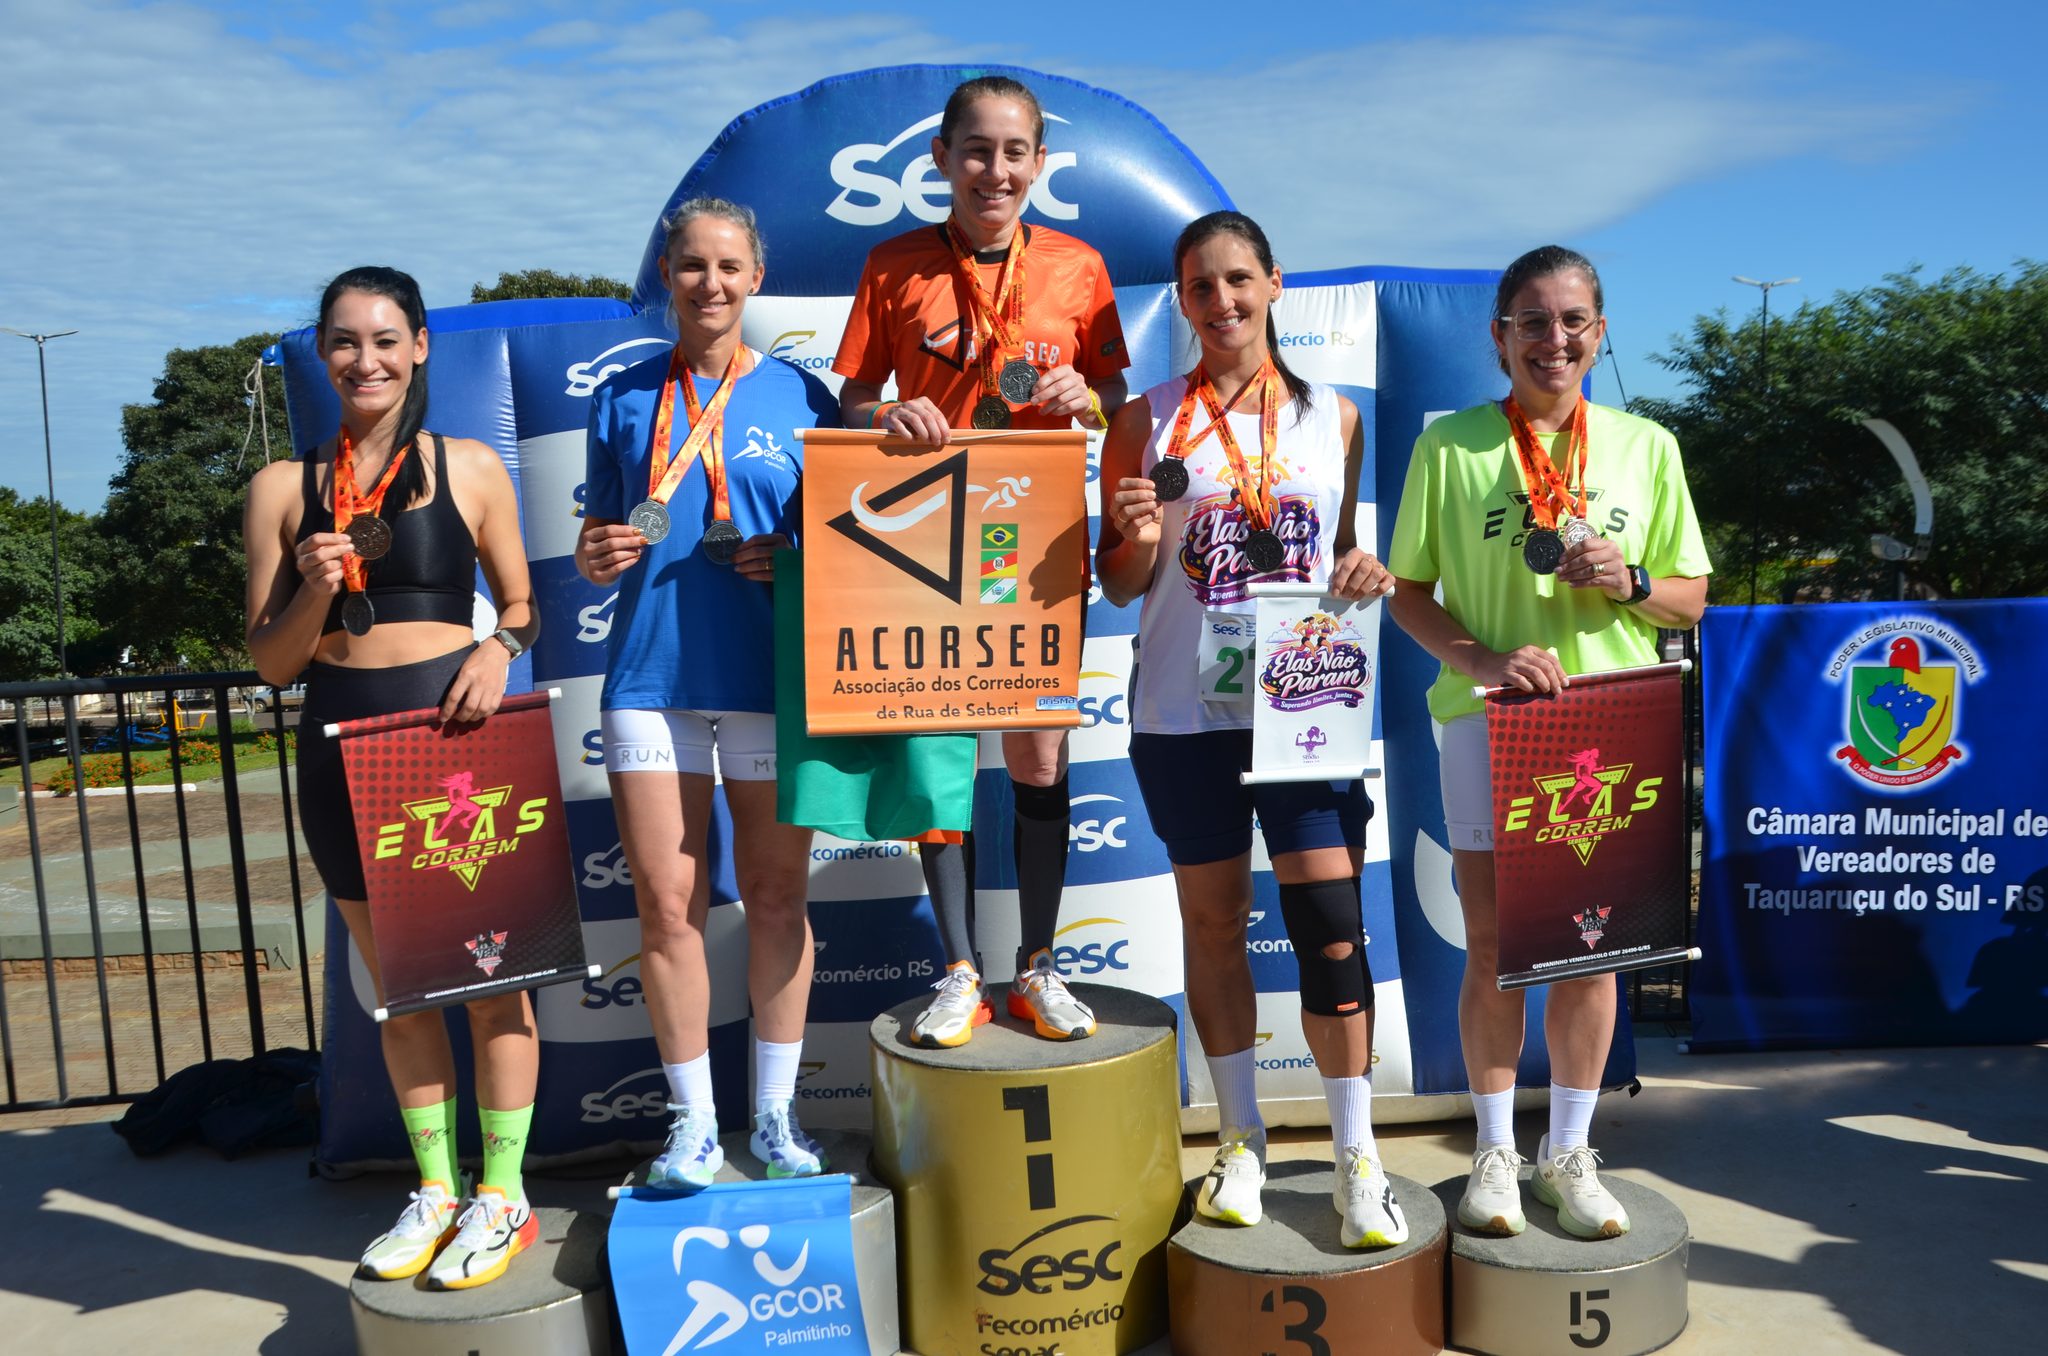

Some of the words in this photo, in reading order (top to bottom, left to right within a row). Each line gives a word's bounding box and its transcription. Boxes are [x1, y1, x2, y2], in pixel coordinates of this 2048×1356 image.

[966, 339, 1060, 365] ASEB
[1279, 332, 1325, 347] ércio
[1331, 331, 1355, 346] RS
[763, 449, 786, 465] GCOR
[1193, 509, 1249, 554] Elas
[836, 623, 1060, 671] ACORSEB
[1830, 642, 1859, 678] PODER
[1859, 620, 1935, 644] LEGISLATIVO
[1936, 628, 1979, 678] MUNICIPAL
[1271, 650, 1314, 678] Elas
[1310, 650, 1358, 675] Não
[833, 677, 925, 697] Associação
[931, 676, 961, 691] dos
[966, 673, 1060, 691] Corredores
[1279, 668, 1361, 698] Param
[876, 706, 897, 720] de
[903, 706, 935, 719] Rua
[940, 704, 959, 718] de
[966, 701, 1019, 717] Seberi
[621, 749, 670, 764] RUN
[1859, 766, 1879, 781] PODER
[1535, 815, 1632, 843] CORREM
[1746, 806, 1856, 836] Câmara
[1865, 808, 2005, 842] Municipal
[2013, 809, 2048, 837] de
[411, 836, 520, 869] CORREM
[813, 842, 901, 861] comércio
[1796, 845, 1953, 874] Vereadores
[1961, 847, 1996, 874] de
[1743, 883, 1885, 916] Taquaruçu
[1893, 883, 1928, 911] do
[1936, 884, 1980, 912] Sul
[2005, 884, 2045, 912] RS
[813, 964, 902, 983] comércio
[908, 959, 934, 978] RS
[1053, 939, 1129, 976] esc
[1002, 1084, 1056, 1211] 1
[750, 1283, 846, 1322] GCOR
[978, 1302, 1125, 1336] Fecomércio
[1261, 1285, 1331, 1356] 3
[1568, 1288, 1611, 1349] 5
[764, 1322, 852, 1348] Palmitinho
